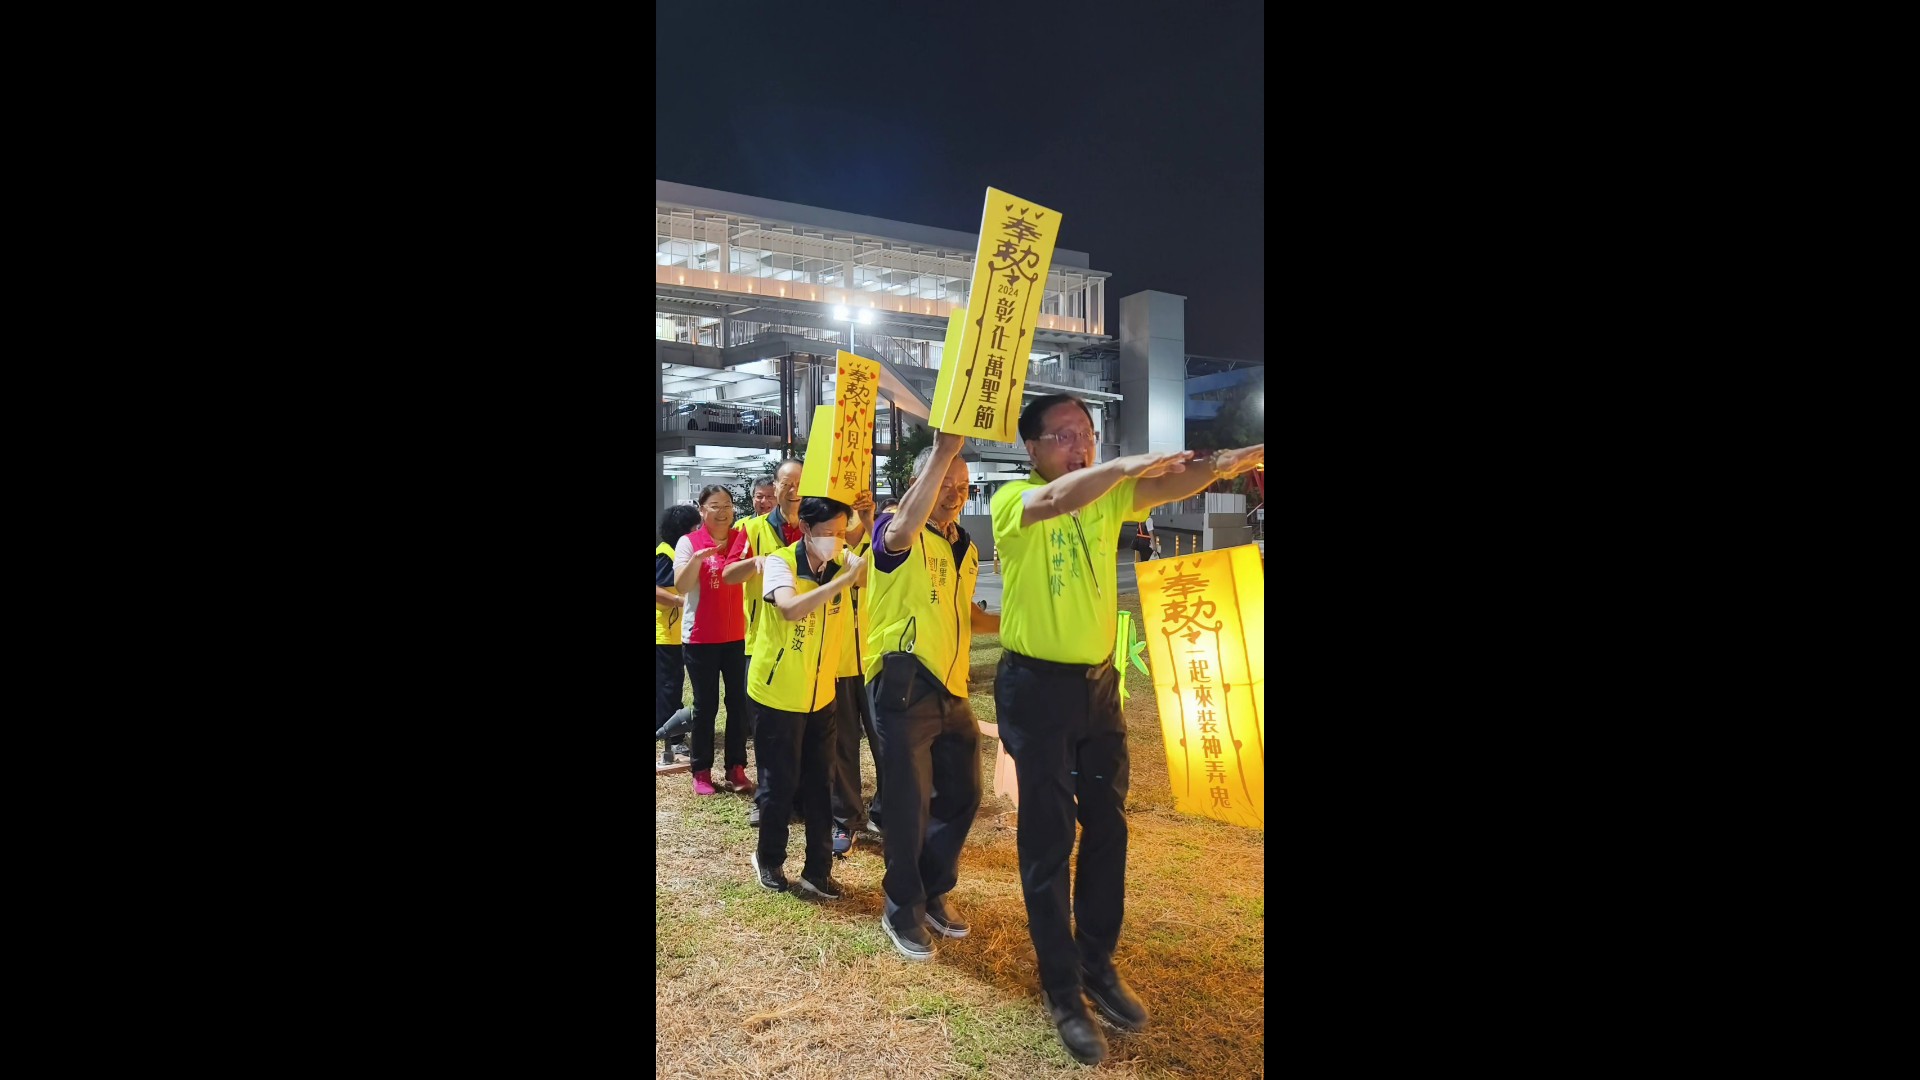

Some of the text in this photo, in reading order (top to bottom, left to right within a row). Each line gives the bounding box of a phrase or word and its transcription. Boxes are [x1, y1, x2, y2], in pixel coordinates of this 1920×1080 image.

[998, 284, 1019, 297] 2024
[973, 298, 1016, 430] 彰化萬聖節
